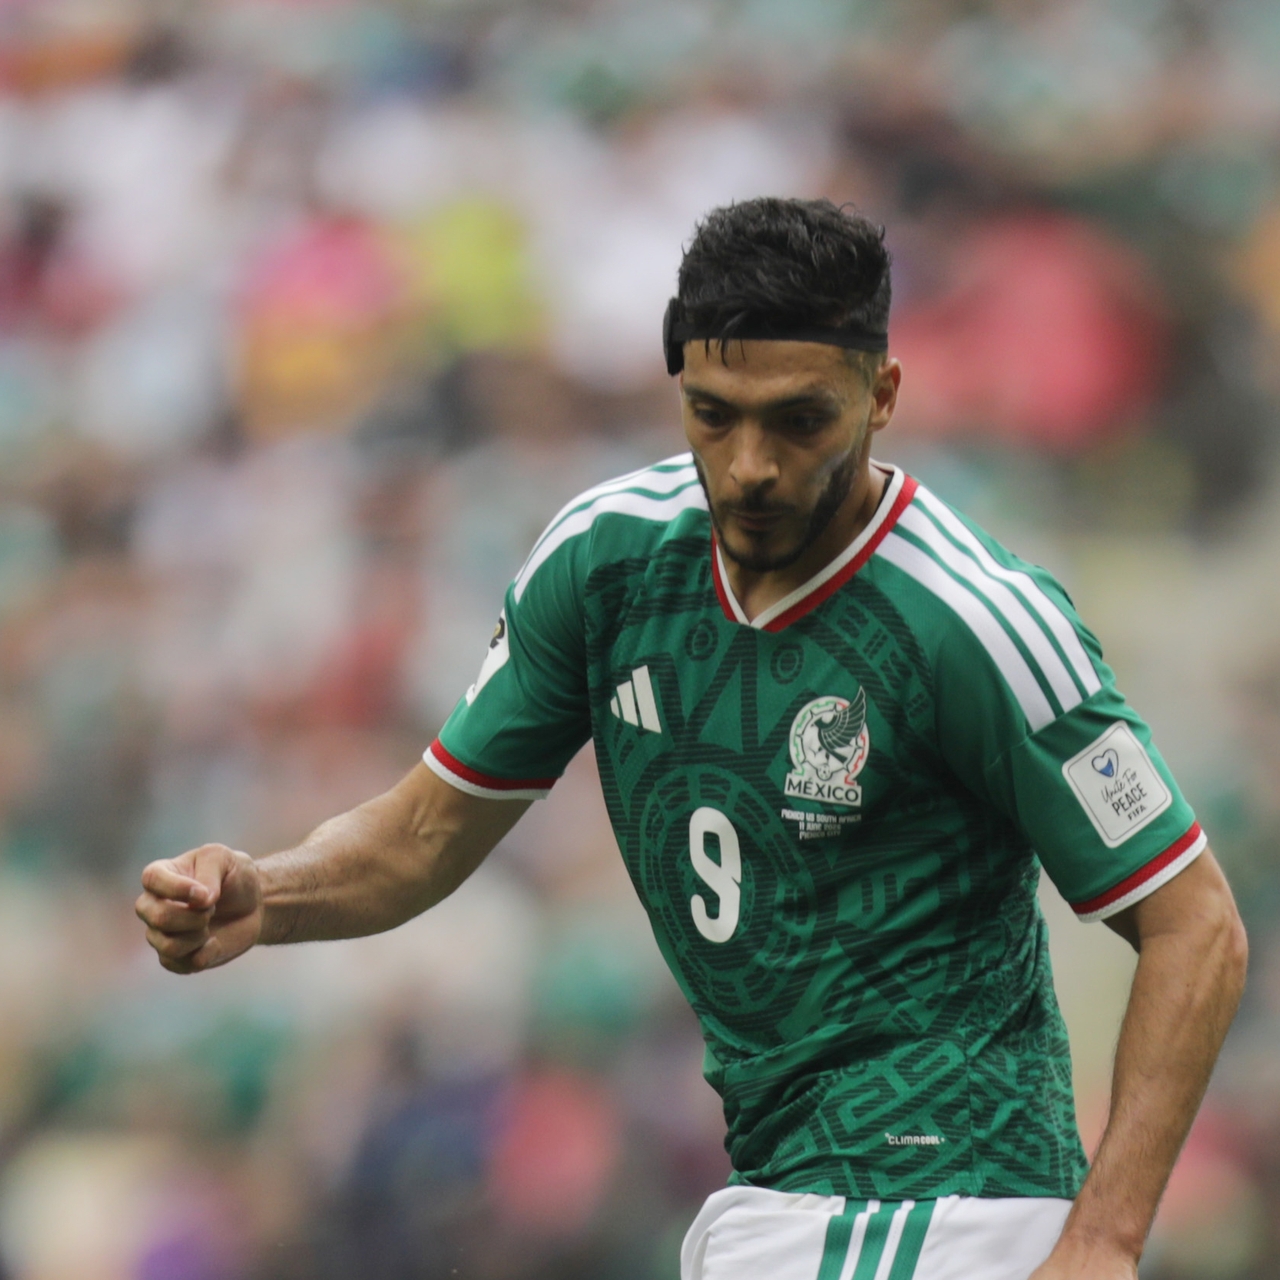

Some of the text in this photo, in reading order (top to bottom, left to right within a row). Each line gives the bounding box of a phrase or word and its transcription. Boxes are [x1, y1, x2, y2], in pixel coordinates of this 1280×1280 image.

[787, 777, 859, 802] MÉXICO
[1112, 782, 1147, 816] PEACE
[1128, 804, 1147, 820] FIFA
[689, 806, 741, 943] 9
[888, 1135, 940, 1145] CLIMACOOL
